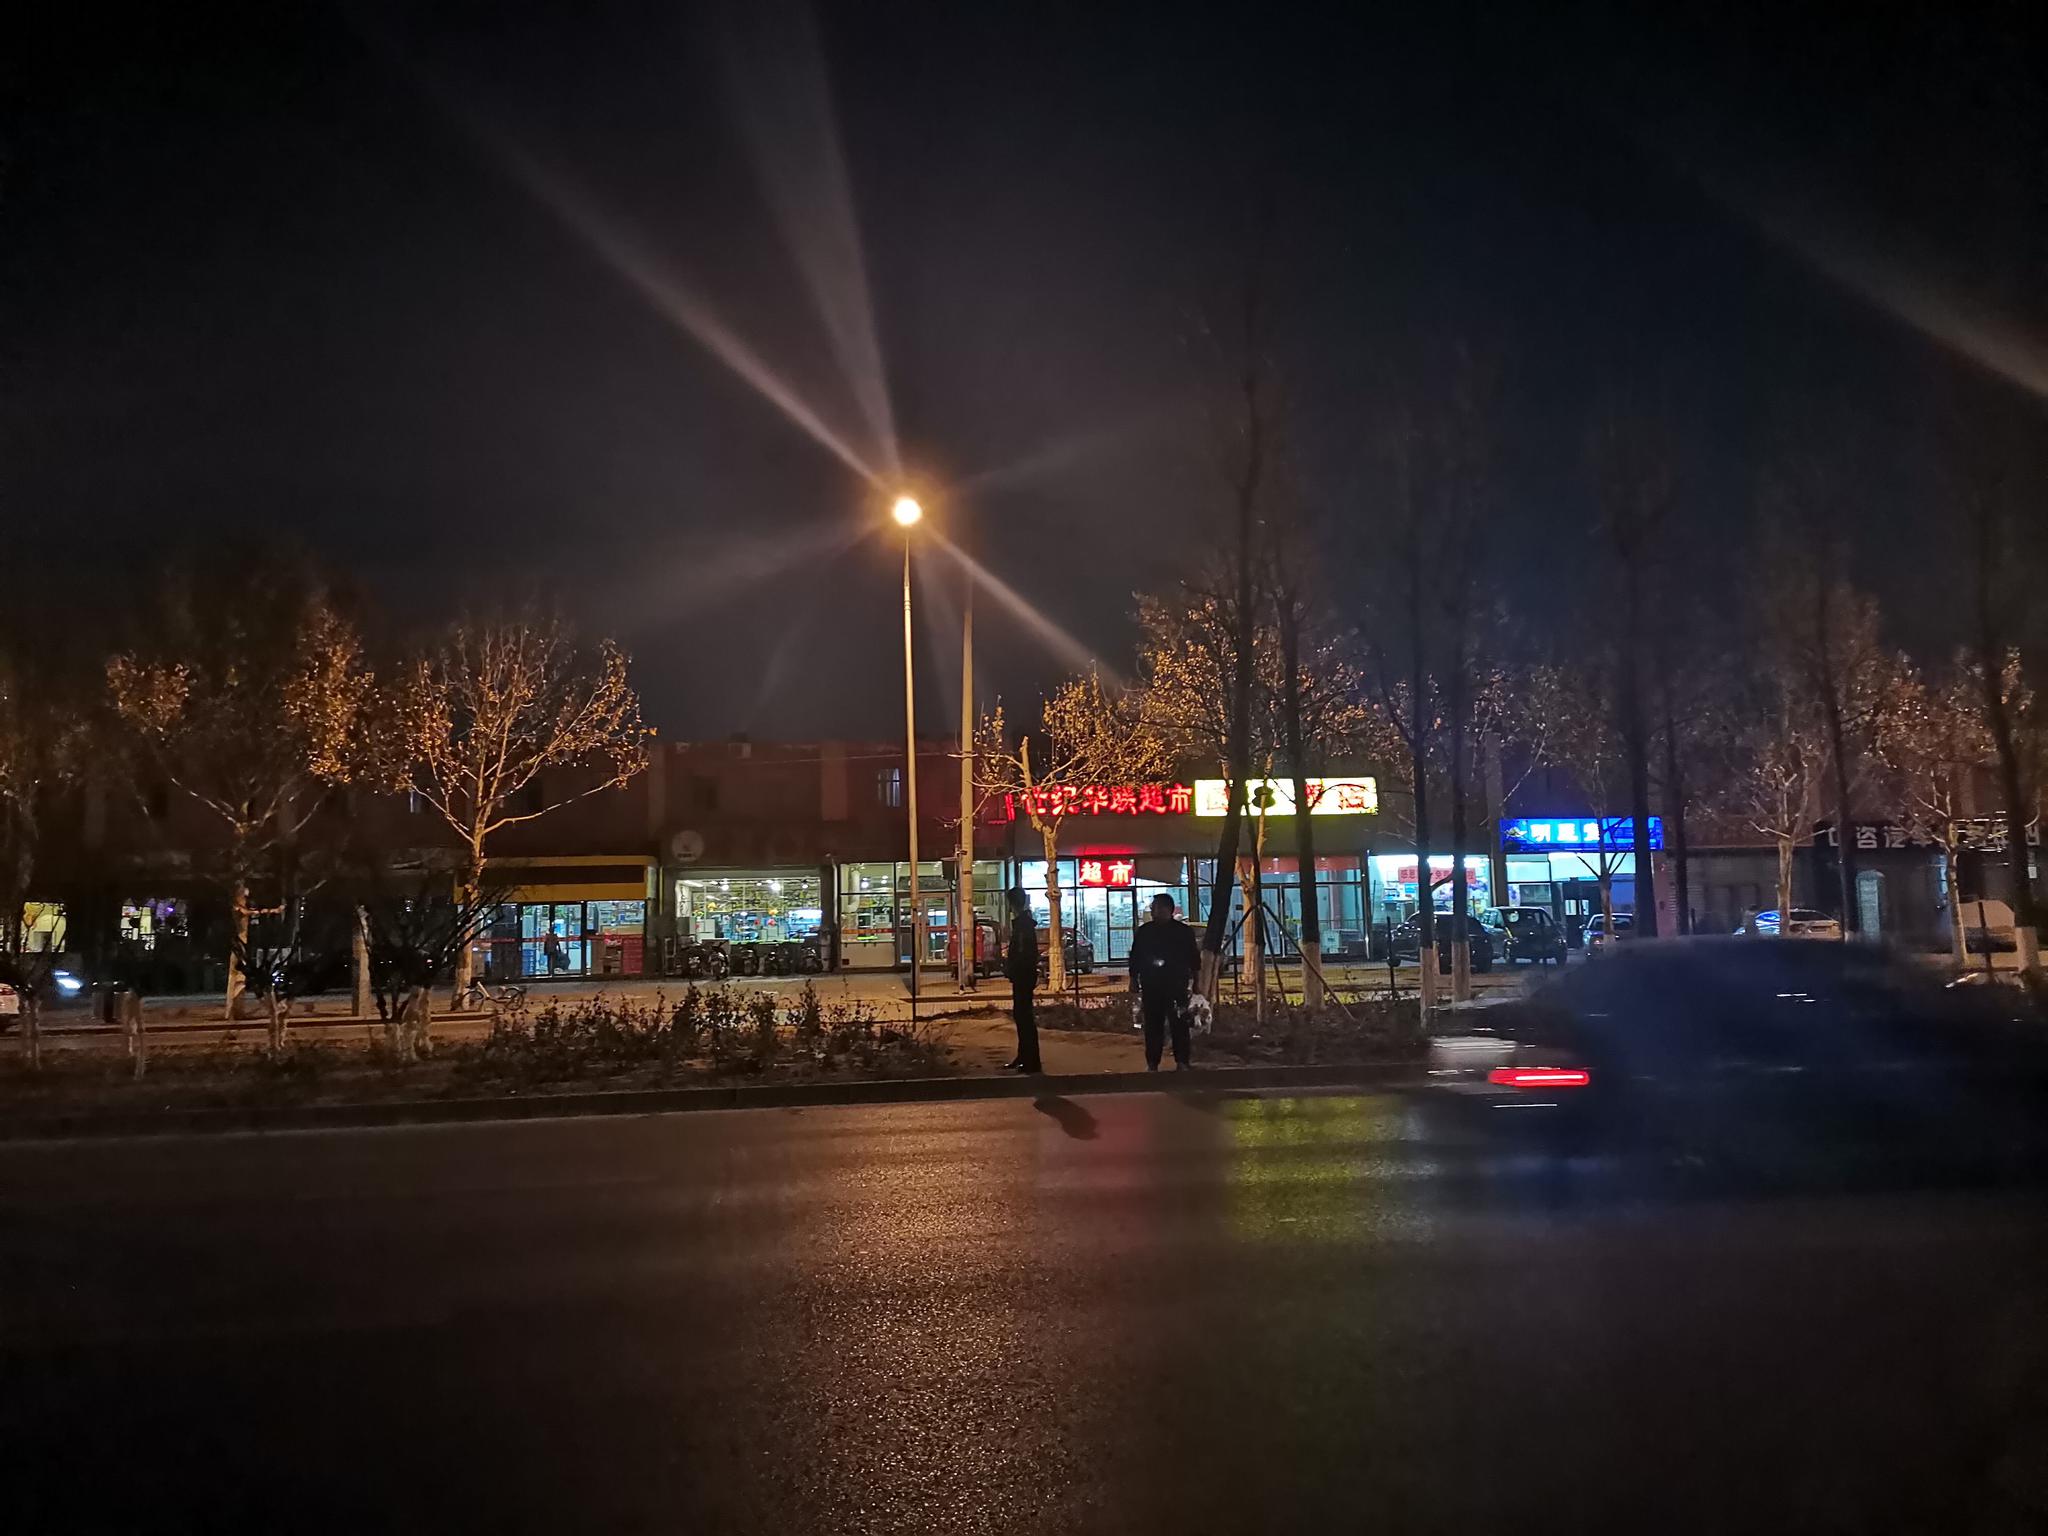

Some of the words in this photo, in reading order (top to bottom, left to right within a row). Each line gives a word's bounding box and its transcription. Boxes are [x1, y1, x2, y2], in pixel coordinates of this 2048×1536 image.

[1021, 782, 1192, 816] 世纪华联超市
[1080, 860, 1133, 885] 超市
